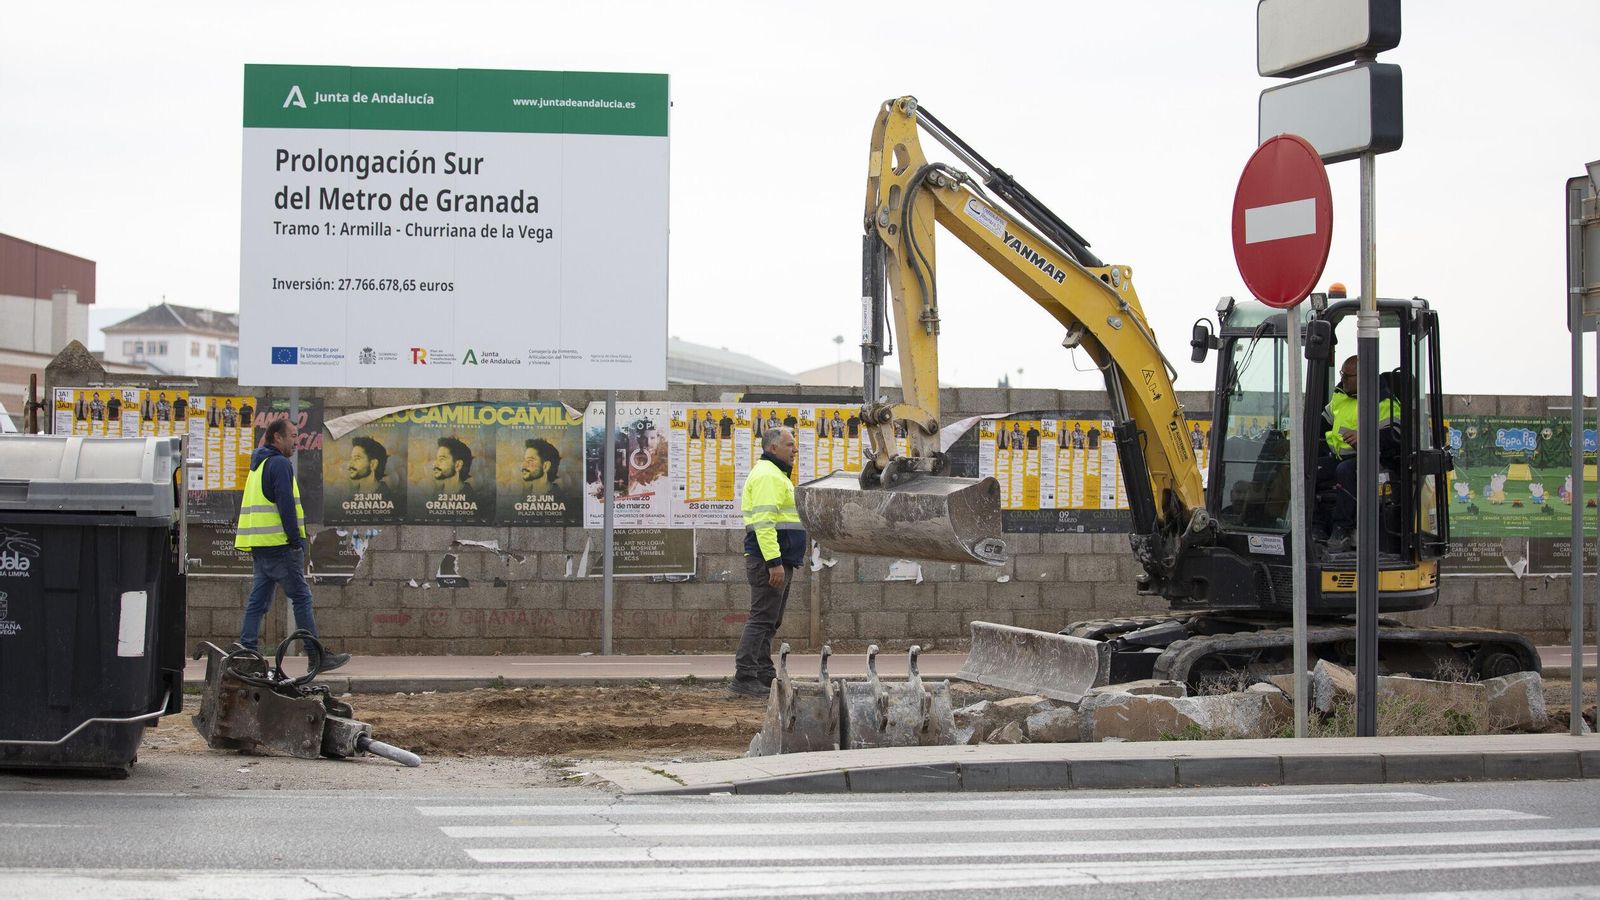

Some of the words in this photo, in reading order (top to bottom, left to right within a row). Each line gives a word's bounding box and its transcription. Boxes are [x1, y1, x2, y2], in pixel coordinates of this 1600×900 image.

[314, 91, 350, 104] Junta
[353, 92, 368, 104] de
[371, 92, 434, 105] Andalucía
[513, 97, 636, 110] www.juntadeandalucia.es
[276, 148, 436, 180] Prolongación
[444, 152, 484, 175] Sur
[274, 186, 310, 210] del
[319, 187, 392, 211] Metro
[400, 187, 428, 212] de
[436, 188, 539, 214] Granada
[274, 221, 320, 236] Tramo
[324, 222, 336, 236] 1:
[340, 221, 392, 237] Armilla
[405, 222, 477, 238] Churriana
[480, 224, 498, 238] de
[502, 224, 514, 238] la
[518, 225, 553, 242] Vega
[1002, 230, 1066, 284] YANMAR
[272, 278, 335, 291] Inversión:
[338, 278, 416, 293] 27.766.678,65
[420, 281, 454, 292] euros
[1498, 431, 1521, 446] Peppa
[1523, 431, 1534, 446] Pig
[342, 501, 394, 510] GRANADA
[426, 502, 477, 510] GRANADA
[514, 502, 565, 511] GRANADA
